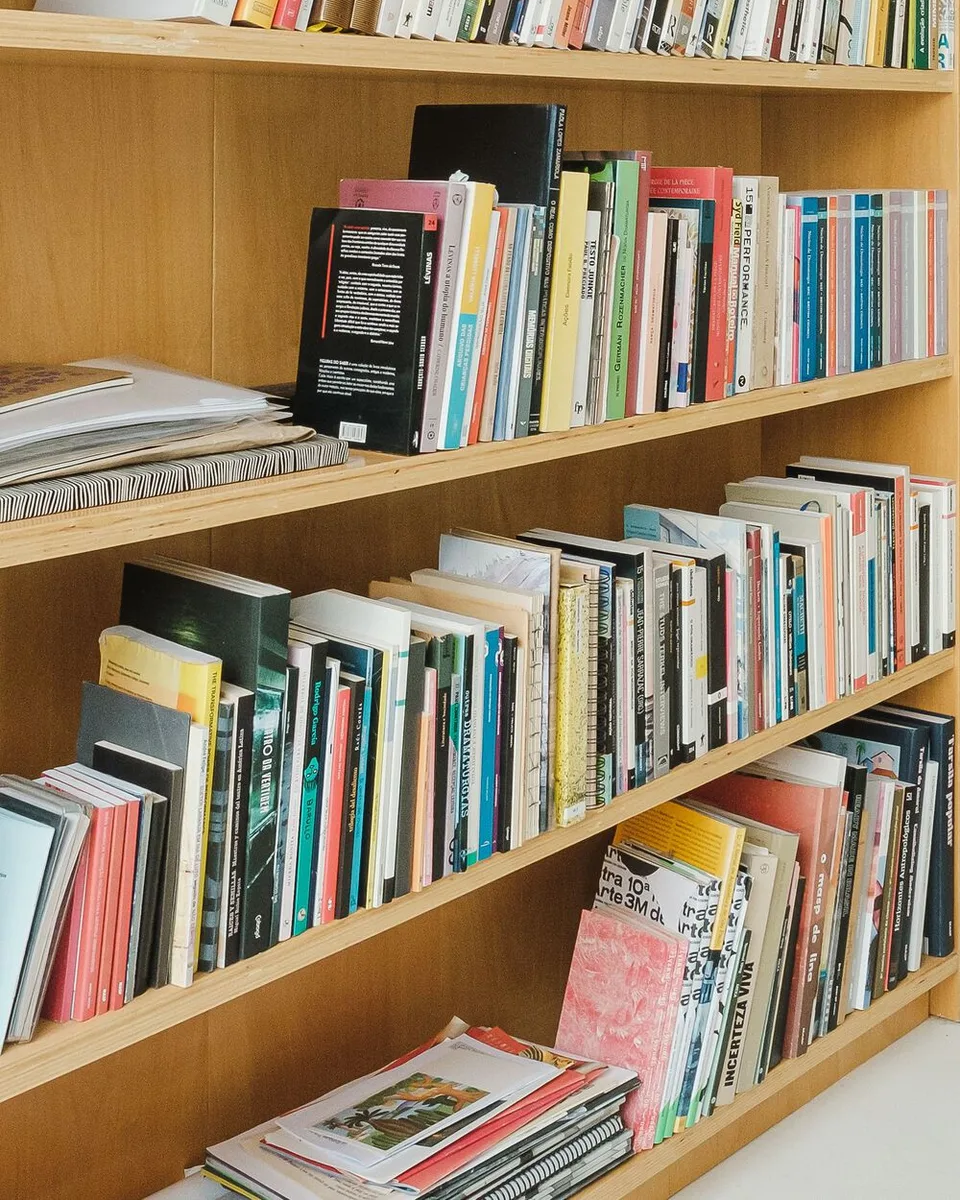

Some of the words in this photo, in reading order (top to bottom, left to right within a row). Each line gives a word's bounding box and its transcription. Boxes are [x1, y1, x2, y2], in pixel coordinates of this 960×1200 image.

[555, 127, 563, 147] LOPES
[552, 147, 561, 179] ZAMARIOLA
[744, 186, 753, 203] 15
[546, 221, 554, 239] COMO
[422, 250, 434, 285] LÉVINAS
[543, 240, 552, 275] DISPOSITIVO
[582, 258, 588, 266] B.
[587, 239, 597, 266] TESTO
[579, 266, 587, 300] PRECIADO
[585, 268, 595, 300] JUNKIE
[524, 309, 537, 348] MEMÓRIAS
[561, 302, 570, 326] Ações
[521, 348, 534, 379] DIGITAIS
[636, 564, 643, 575] 15
[635, 607, 644, 654] JEAN-PIERRE
[635, 654, 645, 693] SARRAZAC
[310, 680, 322, 716] Rodrigo
[462, 689, 470, 717] outras
[309, 716, 320, 745] García
[460, 719, 471, 818] DRAMATURGIAS
[302, 798, 314, 840] BARULLO
[818, 852, 829, 864] o
[898, 807, 911, 879] Antropológicos
[601, 865, 624, 886] tra
[813, 872, 827, 916] masp
[893, 879, 904, 932] Horizontes
[809, 923, 820, 945] de
[805, 950, 817, 984] lina
[719, 996, 750, 1089] INCERTEZA
[738, 958, 757, 998] VIVA
